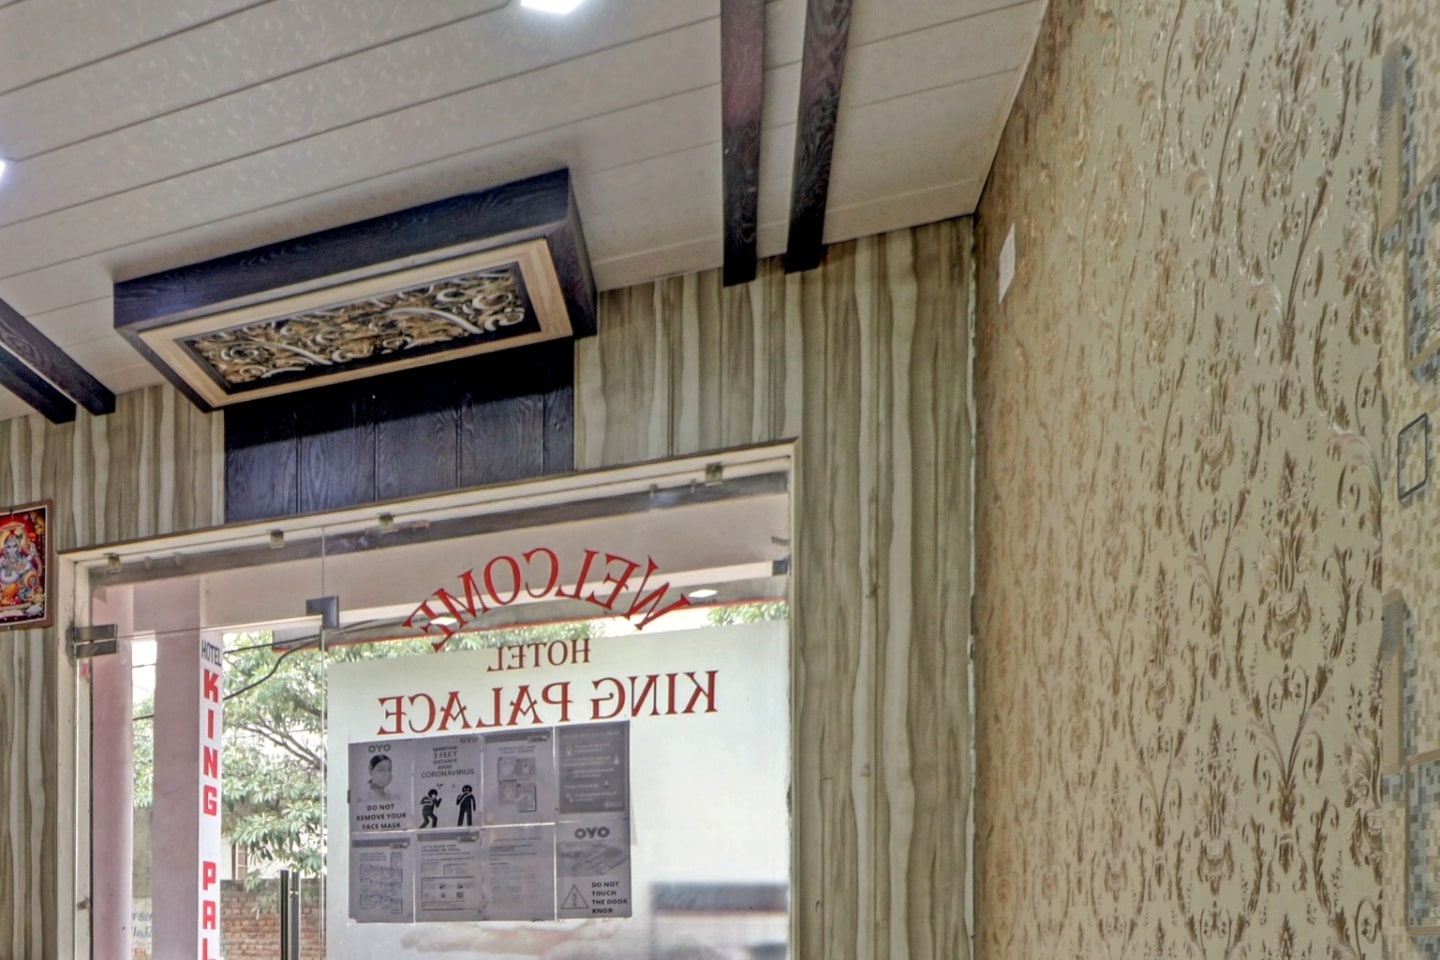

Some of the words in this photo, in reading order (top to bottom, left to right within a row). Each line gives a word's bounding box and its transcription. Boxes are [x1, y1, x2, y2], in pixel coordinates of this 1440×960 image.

[200, 639, 222, 667] HOTEL
[203, 668, 220, 817] KING
[460, 736, 479, 744] OYO
[368, 744, 391, 753] OYO
[421, 768, 475, 779] CORONAVIRUS
[356, 813, 385, 821] REMOVE
[574, 827, 610, 839] OYO
